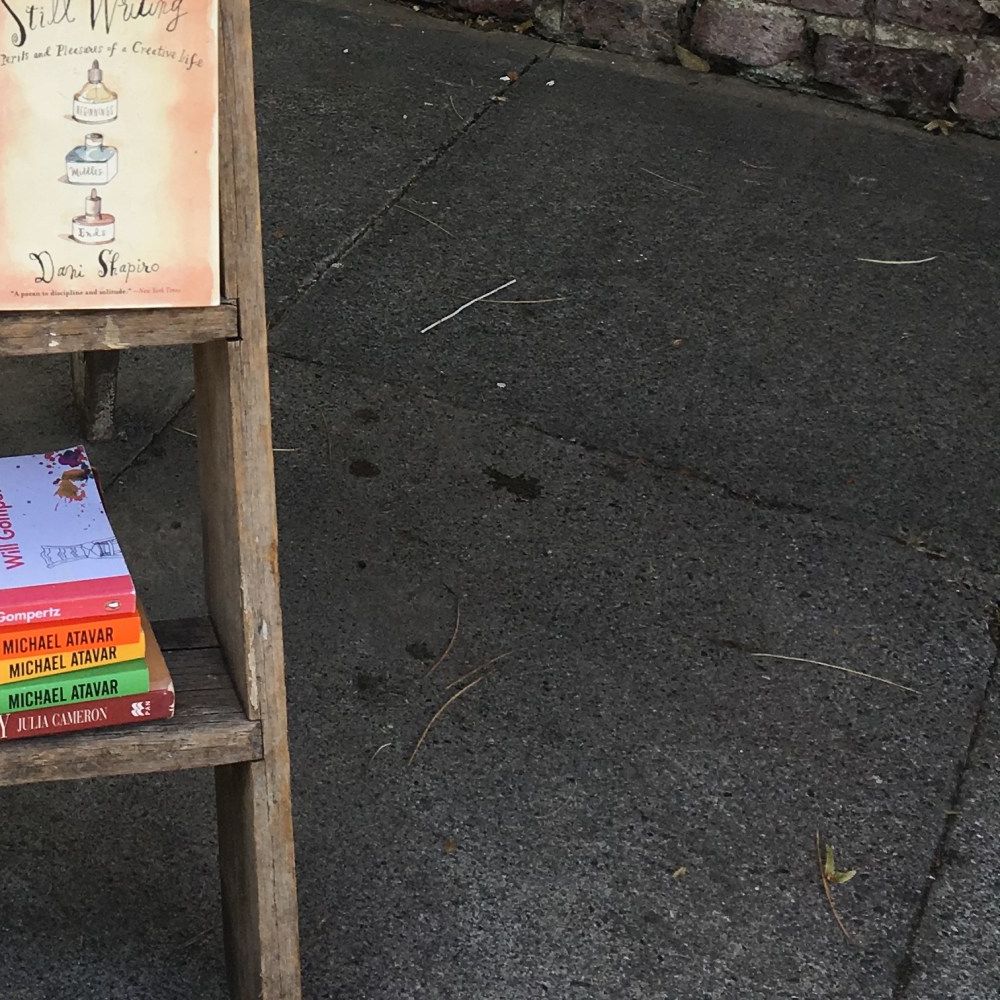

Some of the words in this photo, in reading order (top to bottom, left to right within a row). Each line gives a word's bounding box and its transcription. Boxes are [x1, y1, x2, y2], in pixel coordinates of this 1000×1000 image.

[0, 50, 29, 68] Perils
[33, 47, 52, 60] and
[56, 43, 103, 58] Pleasures
[107, 42, 118, 57] of
[132, 41, 177, 59] Creative
[178, 49, 204, 70] Life
[76, 104, 115, 118] BEGINNINGS
[78, 228, 107, 238] Ends
[28, 250, 85, 284] Dani
[98, 249, 160, 283] Shapiro
[50, 290, 83, 298] discipline
[2, 634, 61, 655] MICHAEL
[66, 627, 114, 647] ATAVAR
[9, 655, 66, 679] MICHAEL
[70, 646, 117, 667] ATAVAR
[8, 687, 67, 710] MICHAEL
[71, 679, 118, 701] ATAVAR
[17, 716, 49, 732] JULIA
[52, 707, 108, 726] CAMERON
